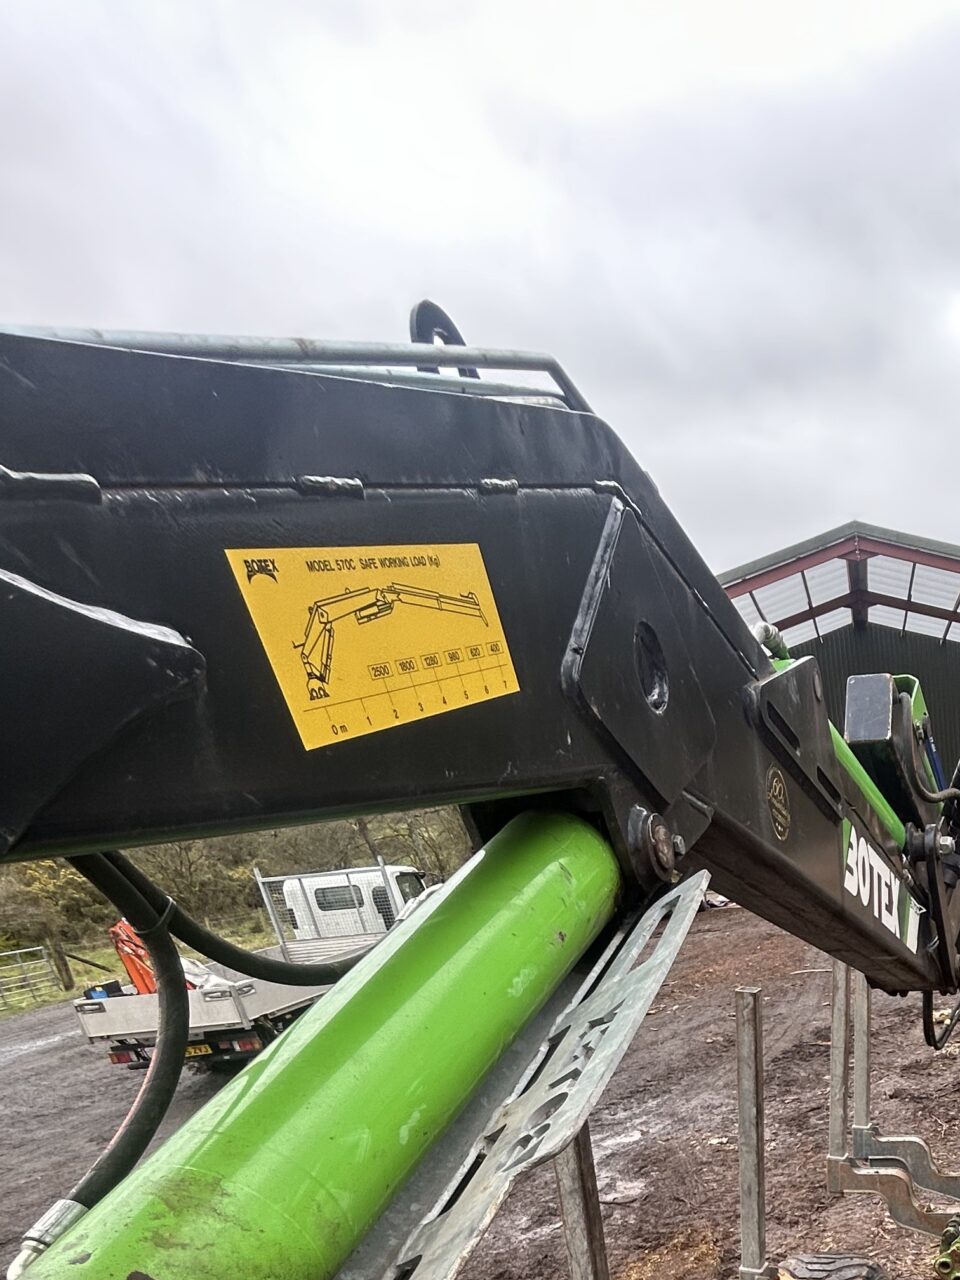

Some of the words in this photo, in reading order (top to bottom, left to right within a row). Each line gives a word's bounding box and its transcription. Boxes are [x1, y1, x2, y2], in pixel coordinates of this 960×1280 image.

[243, 559, 280, 573] BOTEX
[306, 560, 335, 572] MODEL
[335, 559, 356, 571] 570C
[359, 558, 379, 570] SAFE
[378, 556, 410, 569] WORKING
[409, 555, 427, 567] LOAD
[426, 554, 440, 568] (Kg)
[371, 664, 390, 677] 2500
[398, 659, 415, 672] 1800
[490, 643, 501, 653] 400
[331, 724, 339, 735] 0
[339, 724, 348, 733] m
[392, 709, 399, 719] 2
[418, 702, 424, 712] 3
[442, 696, 448, 705] 4
[463, 690, 469, 700] 5
[484, 685, 490, 695] 6
